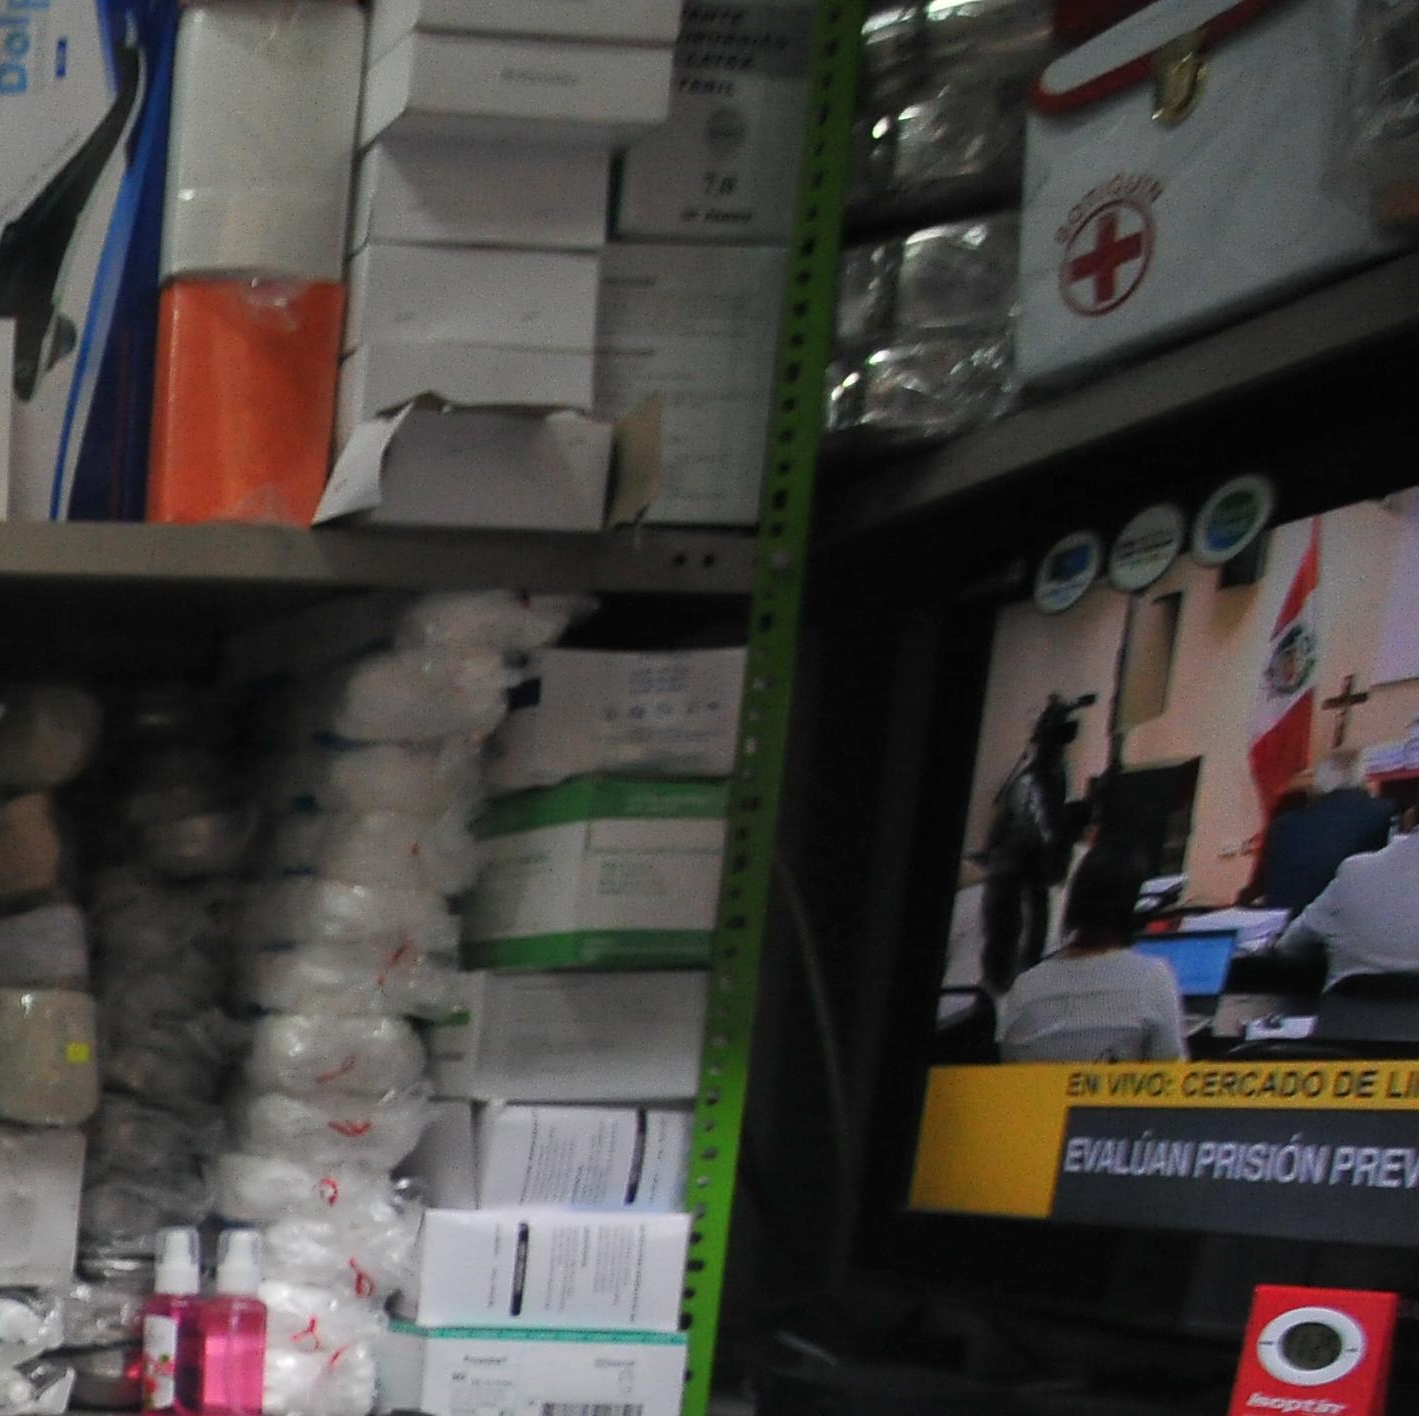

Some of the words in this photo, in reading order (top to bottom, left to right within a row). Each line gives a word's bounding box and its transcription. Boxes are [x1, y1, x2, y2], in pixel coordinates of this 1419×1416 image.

[1065, 1071, 1100, 1097] EN
[1107, 1071, 1173, 1098] VIVO:
[1181, 1070, 1328, 1099] CERCADO
[1331, 1070, 1378, 1098] DE
[1063, 1128, 1195, 1178] EVALÚAN
[1192, 1131, 1332, 1185] PRISIÓN
